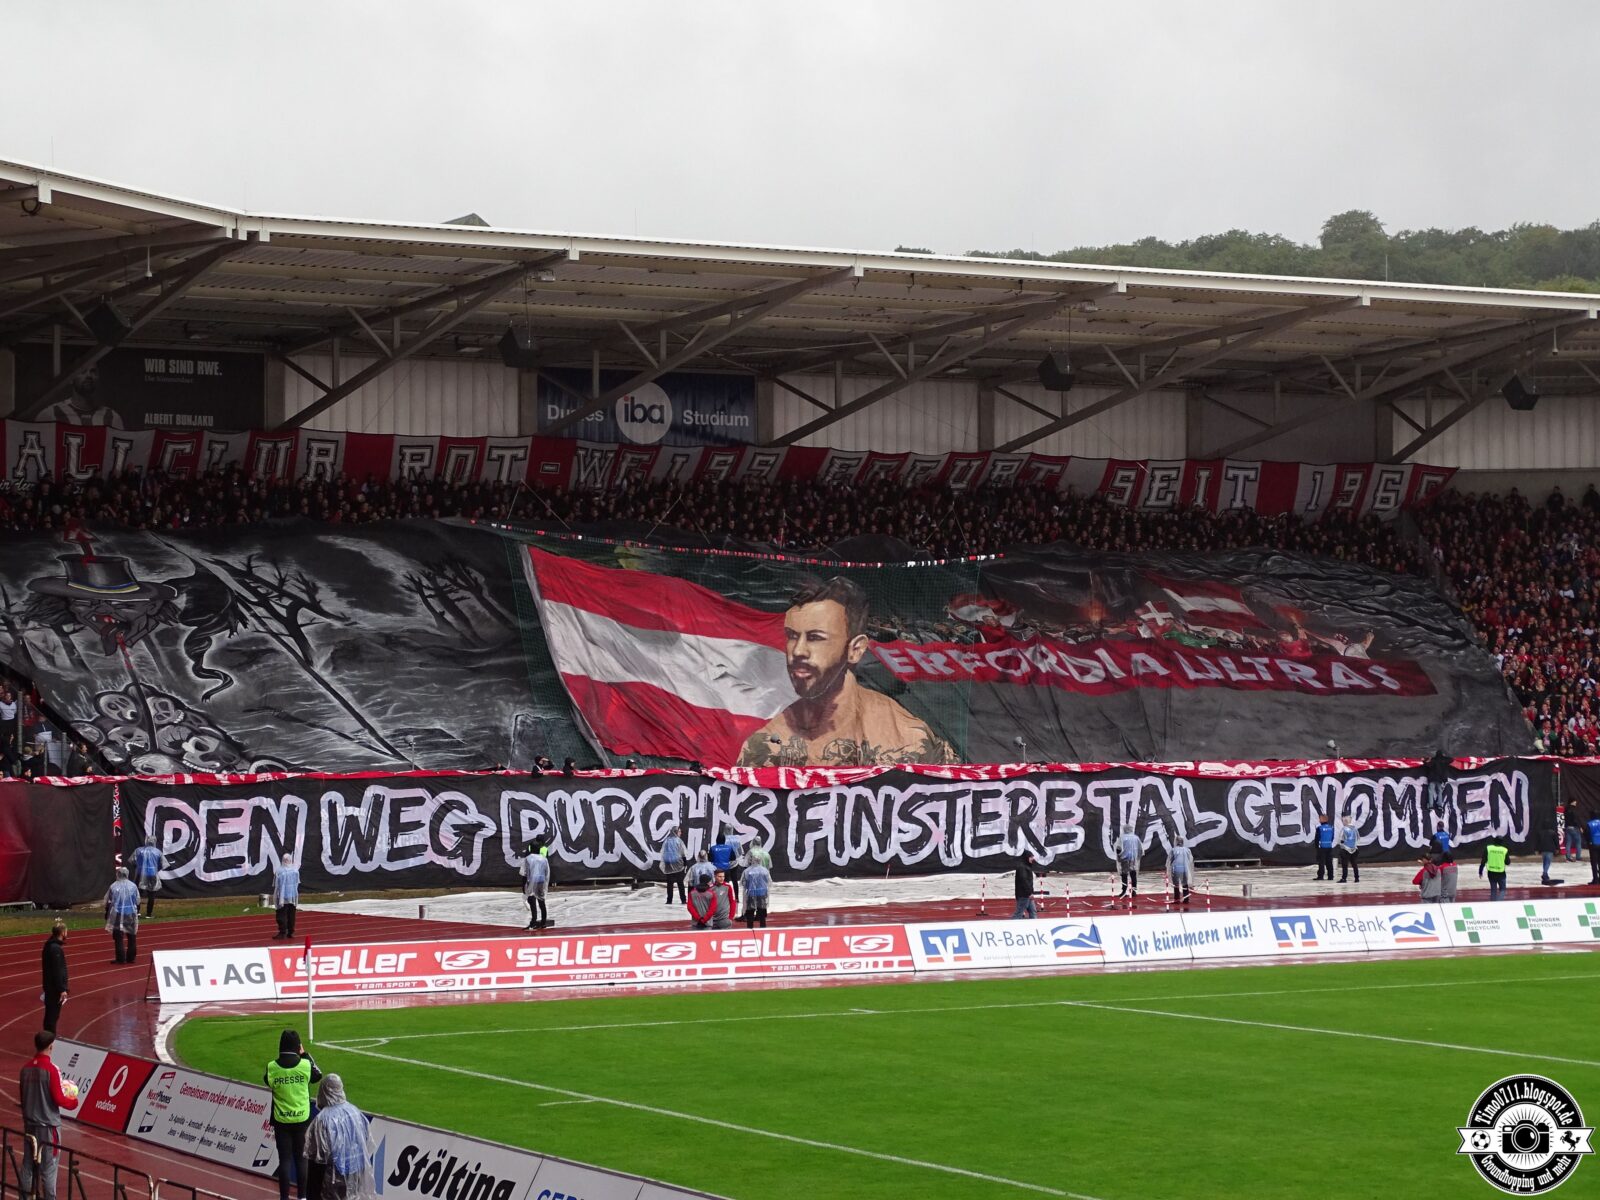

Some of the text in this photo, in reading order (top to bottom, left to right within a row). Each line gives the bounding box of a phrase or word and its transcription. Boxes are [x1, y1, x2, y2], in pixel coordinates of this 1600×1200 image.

[144, 358, 223, 376] WIR SIND RWE.
[144, 412, 173, 425] ALBERT
[547, 404, 604, 422] Dues
[624, 395, 665, 424] iba
[683, 409, 749, 428] Studium
[1105, 466, 1258, 510] SEIT
[881, 642, 1402, 690] ERFORDIA ULTRAS
[146, 797, 305, 882] DEN
[321, 785, 497, 876] WEG
[502, 784, 776, 869] DURCHS
[789, 780, 1084, 867] FINSTERE
[1086, 776, 1227, 850] TAL
[1228, 769, 1530, 850] GENOMMEN
[1316, 916, 1387, 934] VR-Bank
[971, 930, 1048, 948] VR-Bank
[1121, 916, 1254, 957] Wir kümmern uns!
[163, 962, 267, 988] NT.AG
[274, 1074, 305, 1085] PRESSE
[180, 1082, 210, 1102] Gemeinsam
[209, 1089, 227, 1106] rocken
[96, 1098, 117, 1113] vodafone
